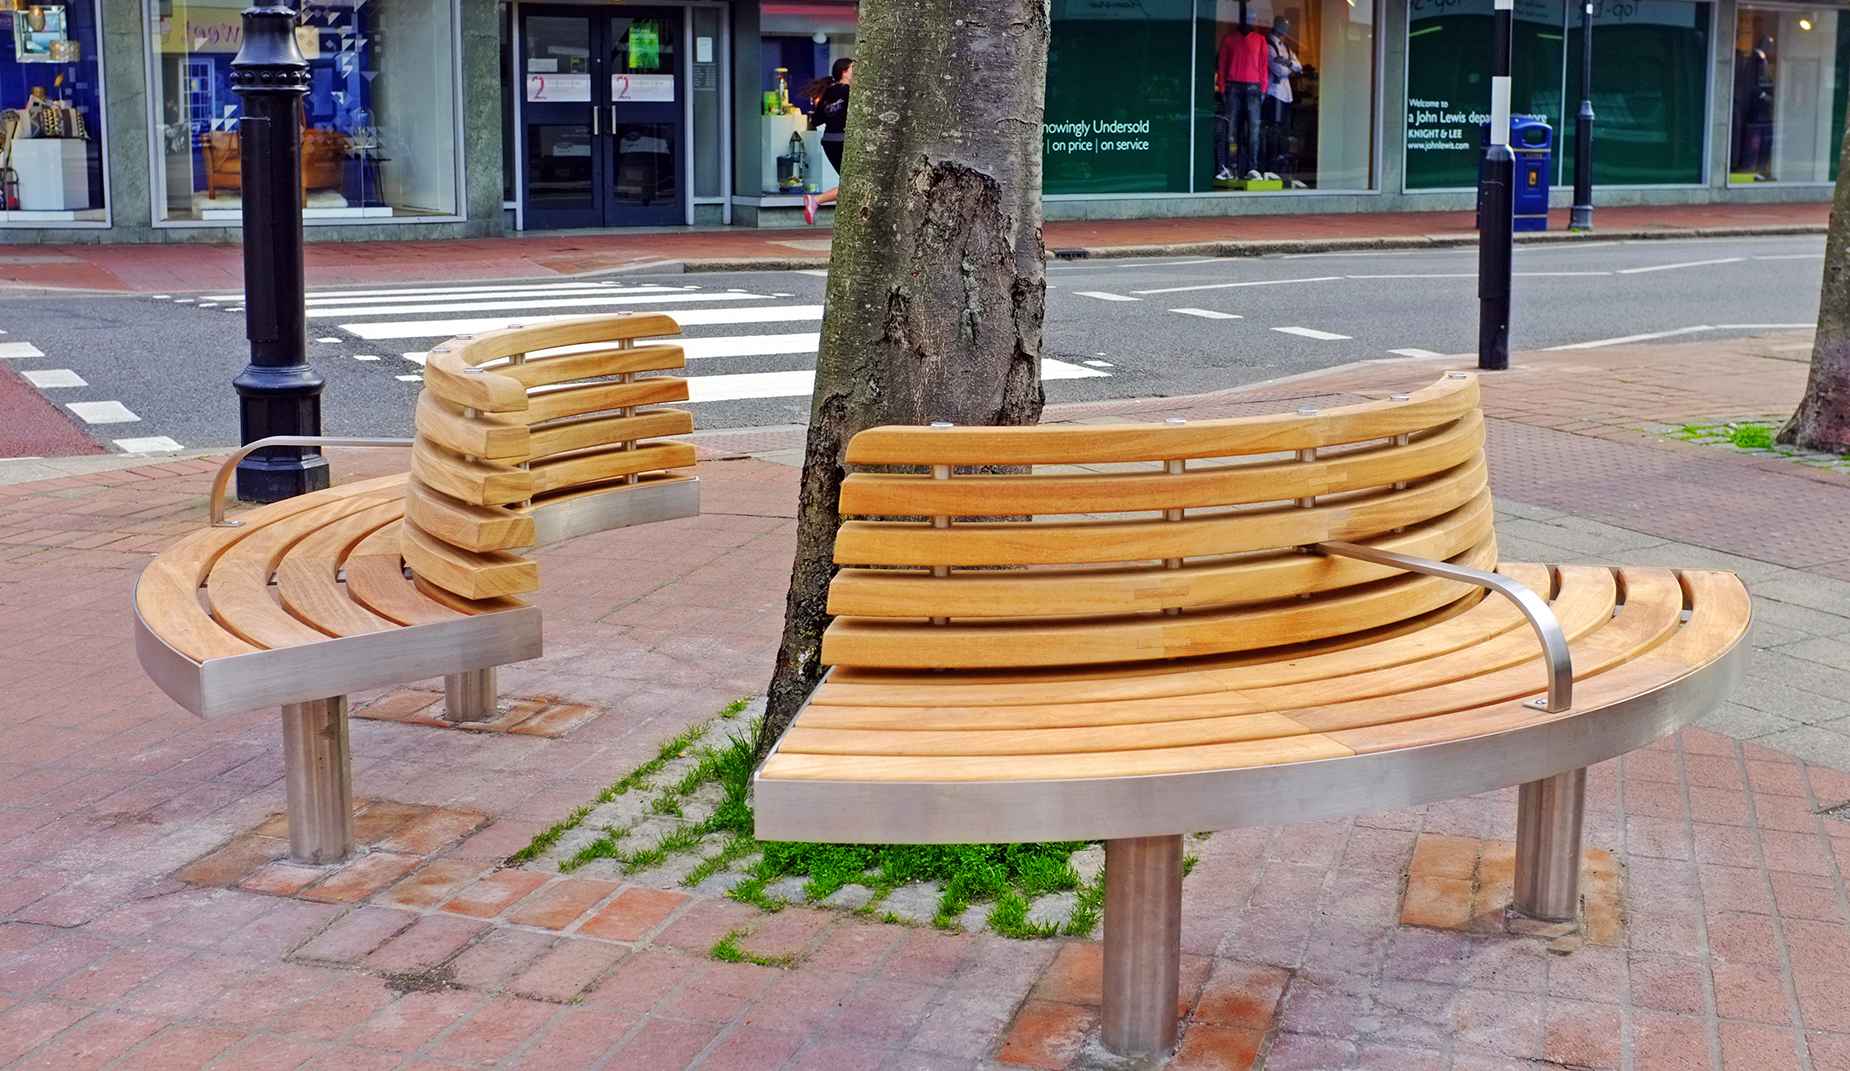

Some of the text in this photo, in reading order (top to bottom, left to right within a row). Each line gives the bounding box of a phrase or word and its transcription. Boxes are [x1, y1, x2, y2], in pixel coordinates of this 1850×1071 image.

[1409, 99, 1448, 108] Welcome to
[1408, 113, 1414, 123] a
[1415, 111, 1437, 126] John
[1440, 111, 1466, 123] Lewis
[1042, 120, 1150, 137] nowingly Undersold
[1408, 129, 1462, 139] KNIGHT & LEE
[1052, 138, 1149, 154] on price on service
[1408, 142, 1469, 151] www.johnlewis.com
